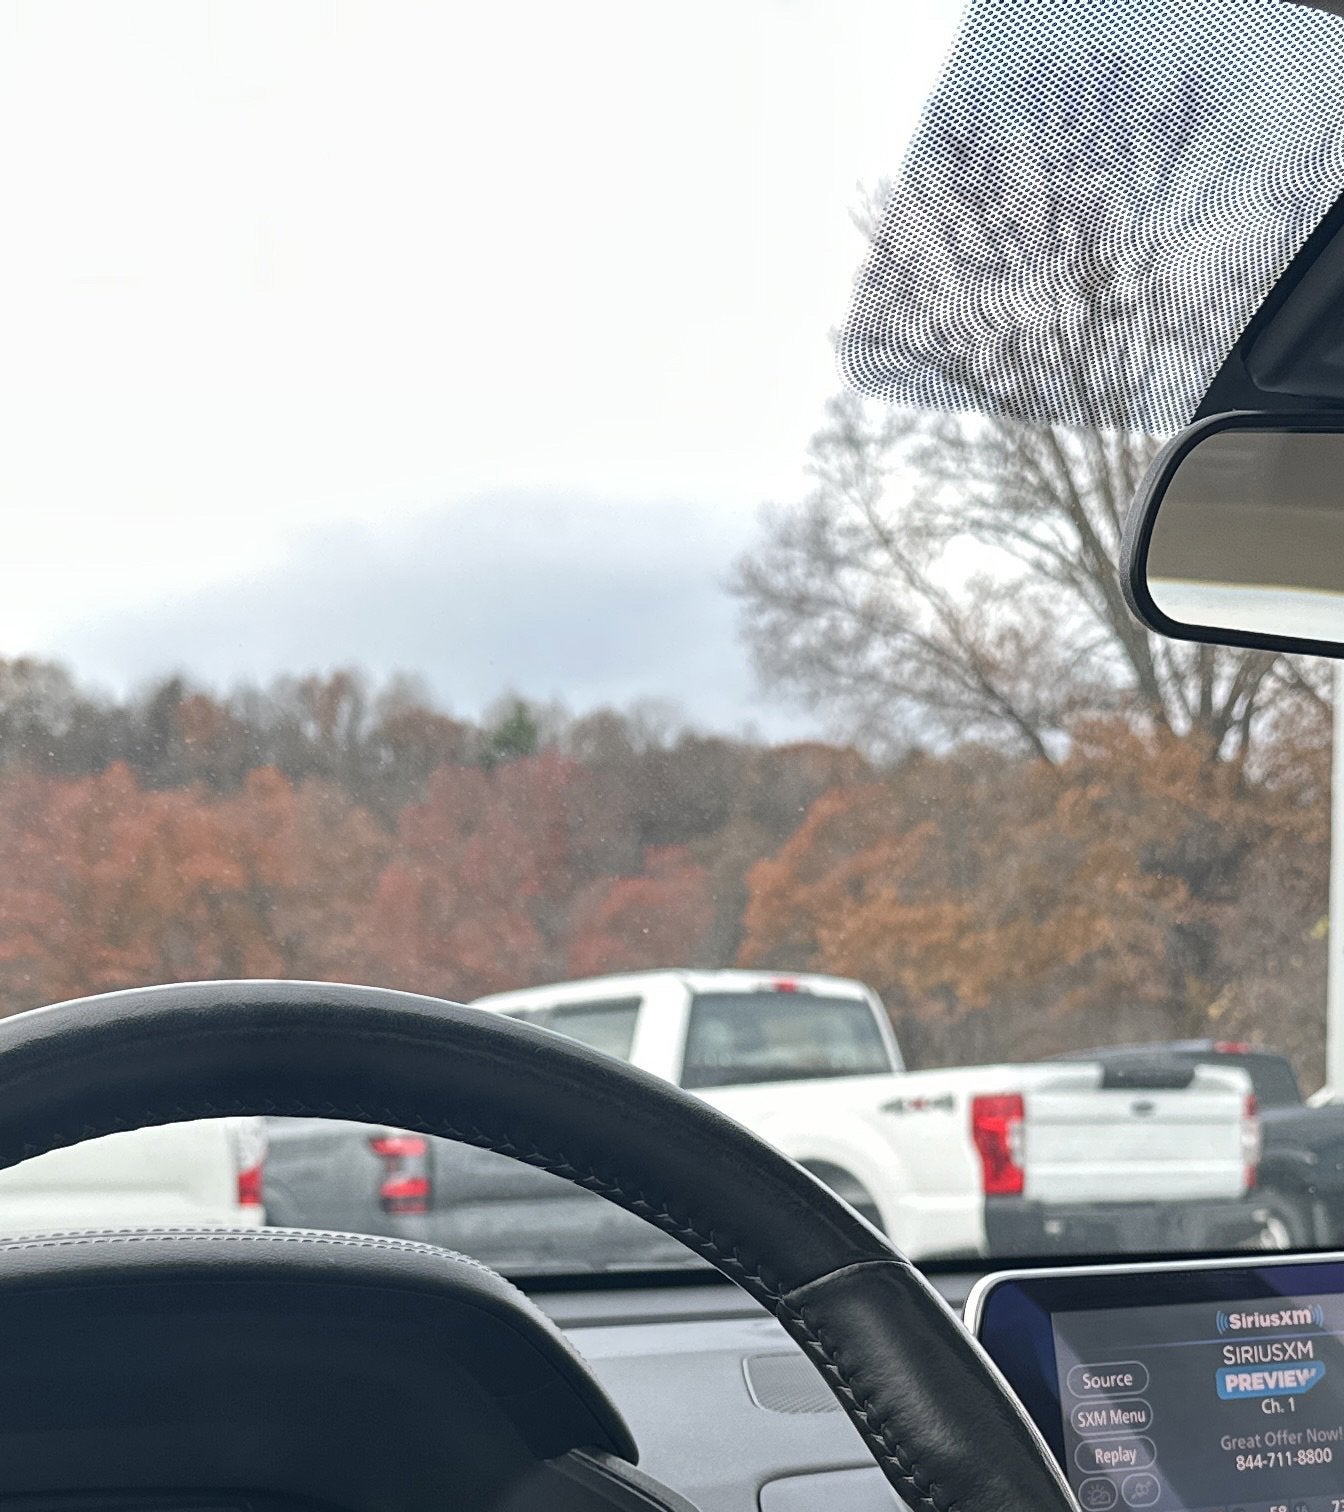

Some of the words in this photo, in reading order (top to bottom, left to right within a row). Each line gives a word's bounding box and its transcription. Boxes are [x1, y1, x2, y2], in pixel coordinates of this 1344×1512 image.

[1222, 1340, 1314, 1365] SIRIUSXM
[1082, 1373, 1133, 1390] Source
[1225, 1368, 1316, 1393] PREVIEW
[1261, 1398, 1285, 1415] Ch.
[1288, 1397, 1296, 1412] 1
[1078, 1412, 1106, 1428] SXM
[1110, 1409, 1146, 1425] Menu
[1220, 1434, 1260, 1451] Great
[1264, 1430, 1303, 1447] Offer
[1306, 1426, 1344, 1443] Now!
[1095, 1445, 1137, 1466] Replay
[1236, 1448, 1332, 1472] 844-711-8800
